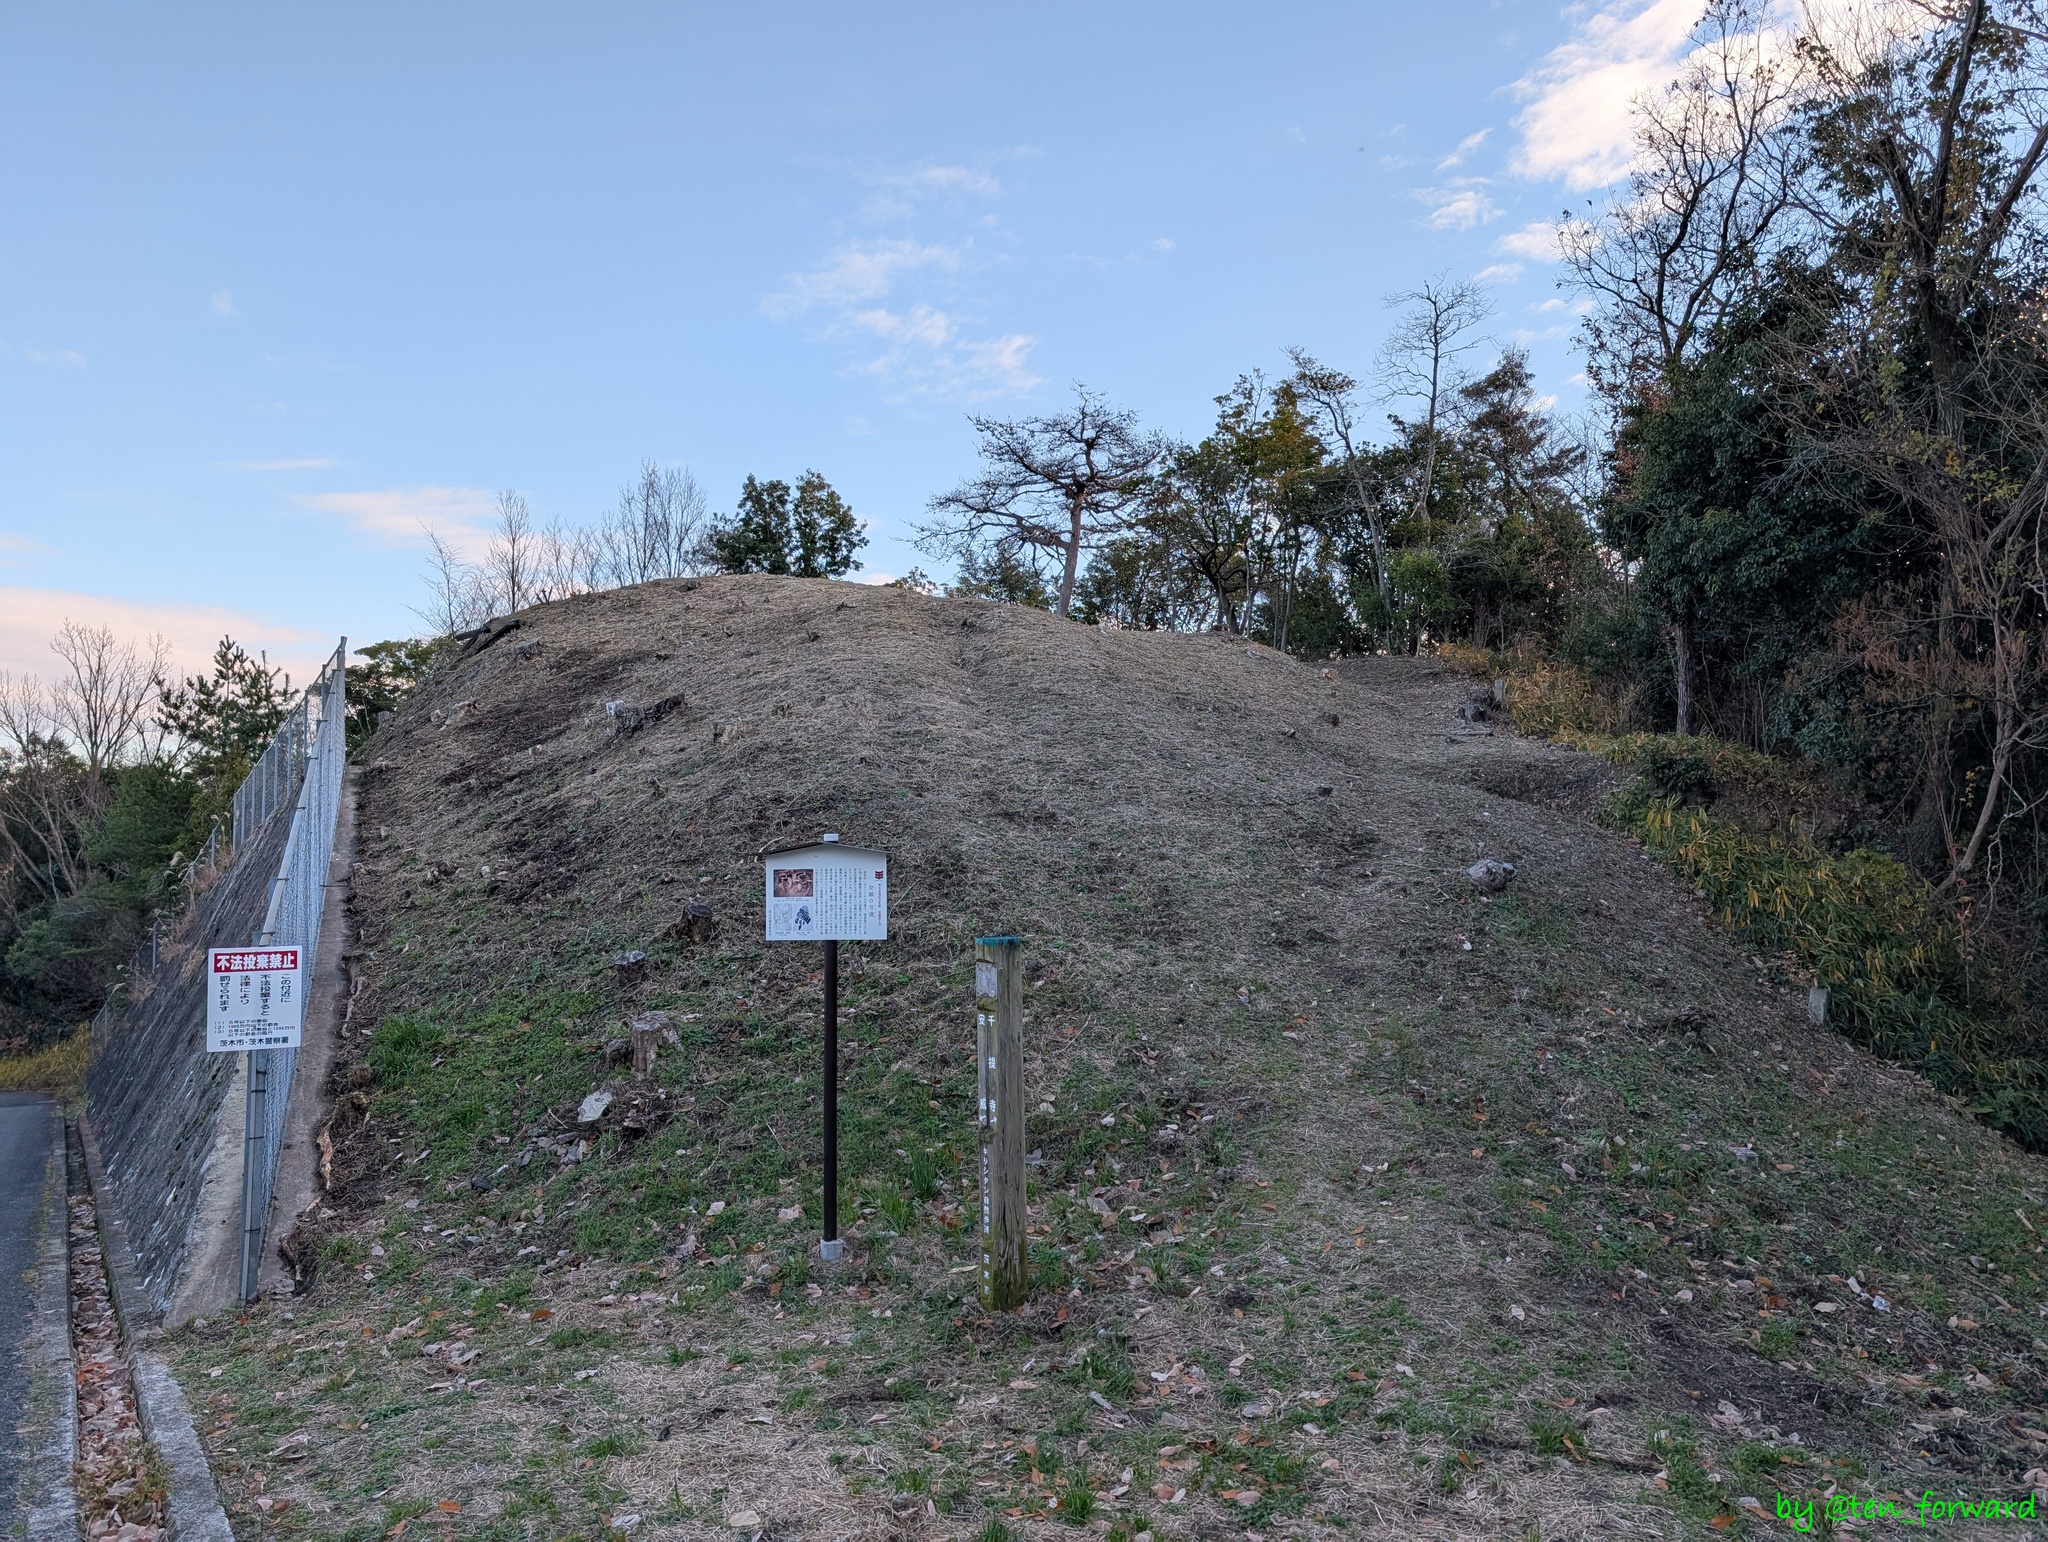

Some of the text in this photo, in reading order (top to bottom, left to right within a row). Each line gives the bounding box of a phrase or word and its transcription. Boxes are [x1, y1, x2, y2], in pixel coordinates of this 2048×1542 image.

[216, 952, 295, 971] 不法投棄禁止
[240, 974, 251, 1005] 法律により
[260, 973, 271, 1016] 不法投棄すると
[280, 973, 291, 1003] この付近に
